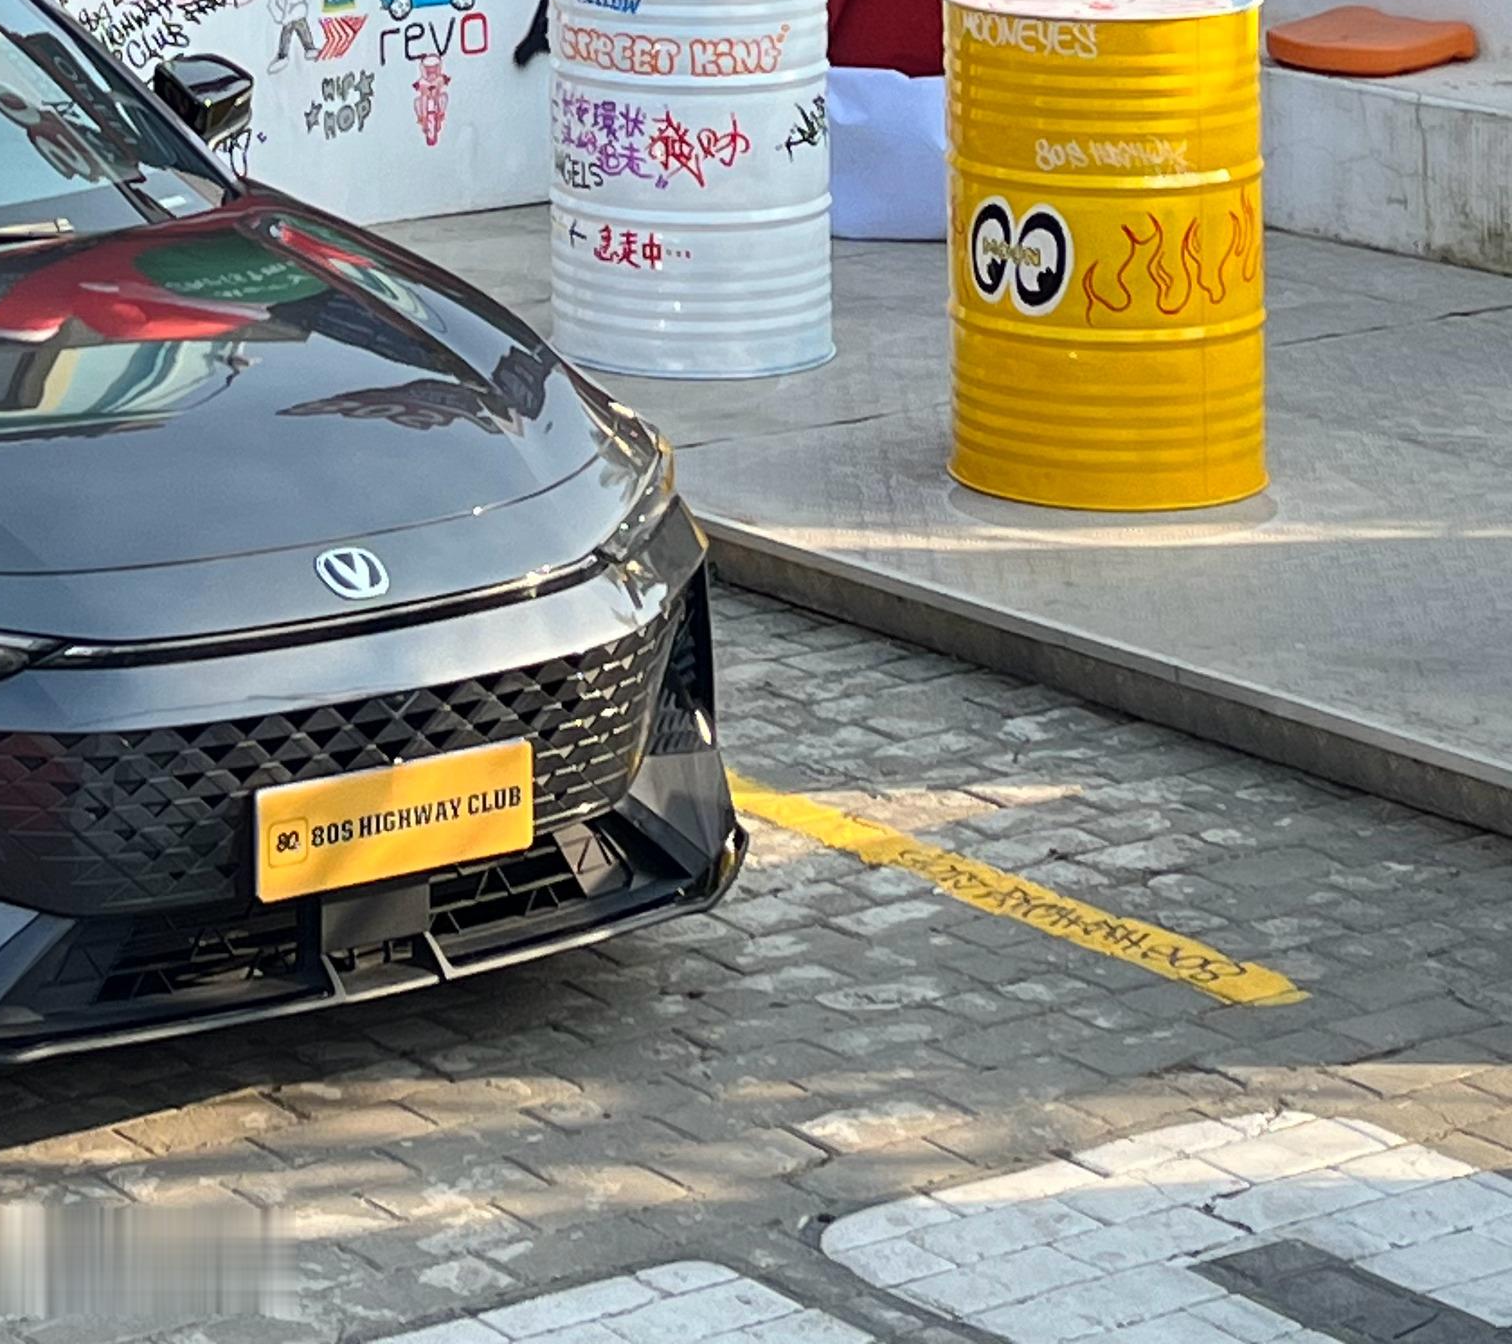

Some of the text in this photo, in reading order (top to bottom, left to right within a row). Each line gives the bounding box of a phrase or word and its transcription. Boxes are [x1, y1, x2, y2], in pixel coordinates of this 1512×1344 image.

[126, 17, 190, 70] CLUB
[310, 818, 354, 848] 80S
[358, 796, 462, 839] HIGHWAY
[467, 784, 522, 816] CLUB
